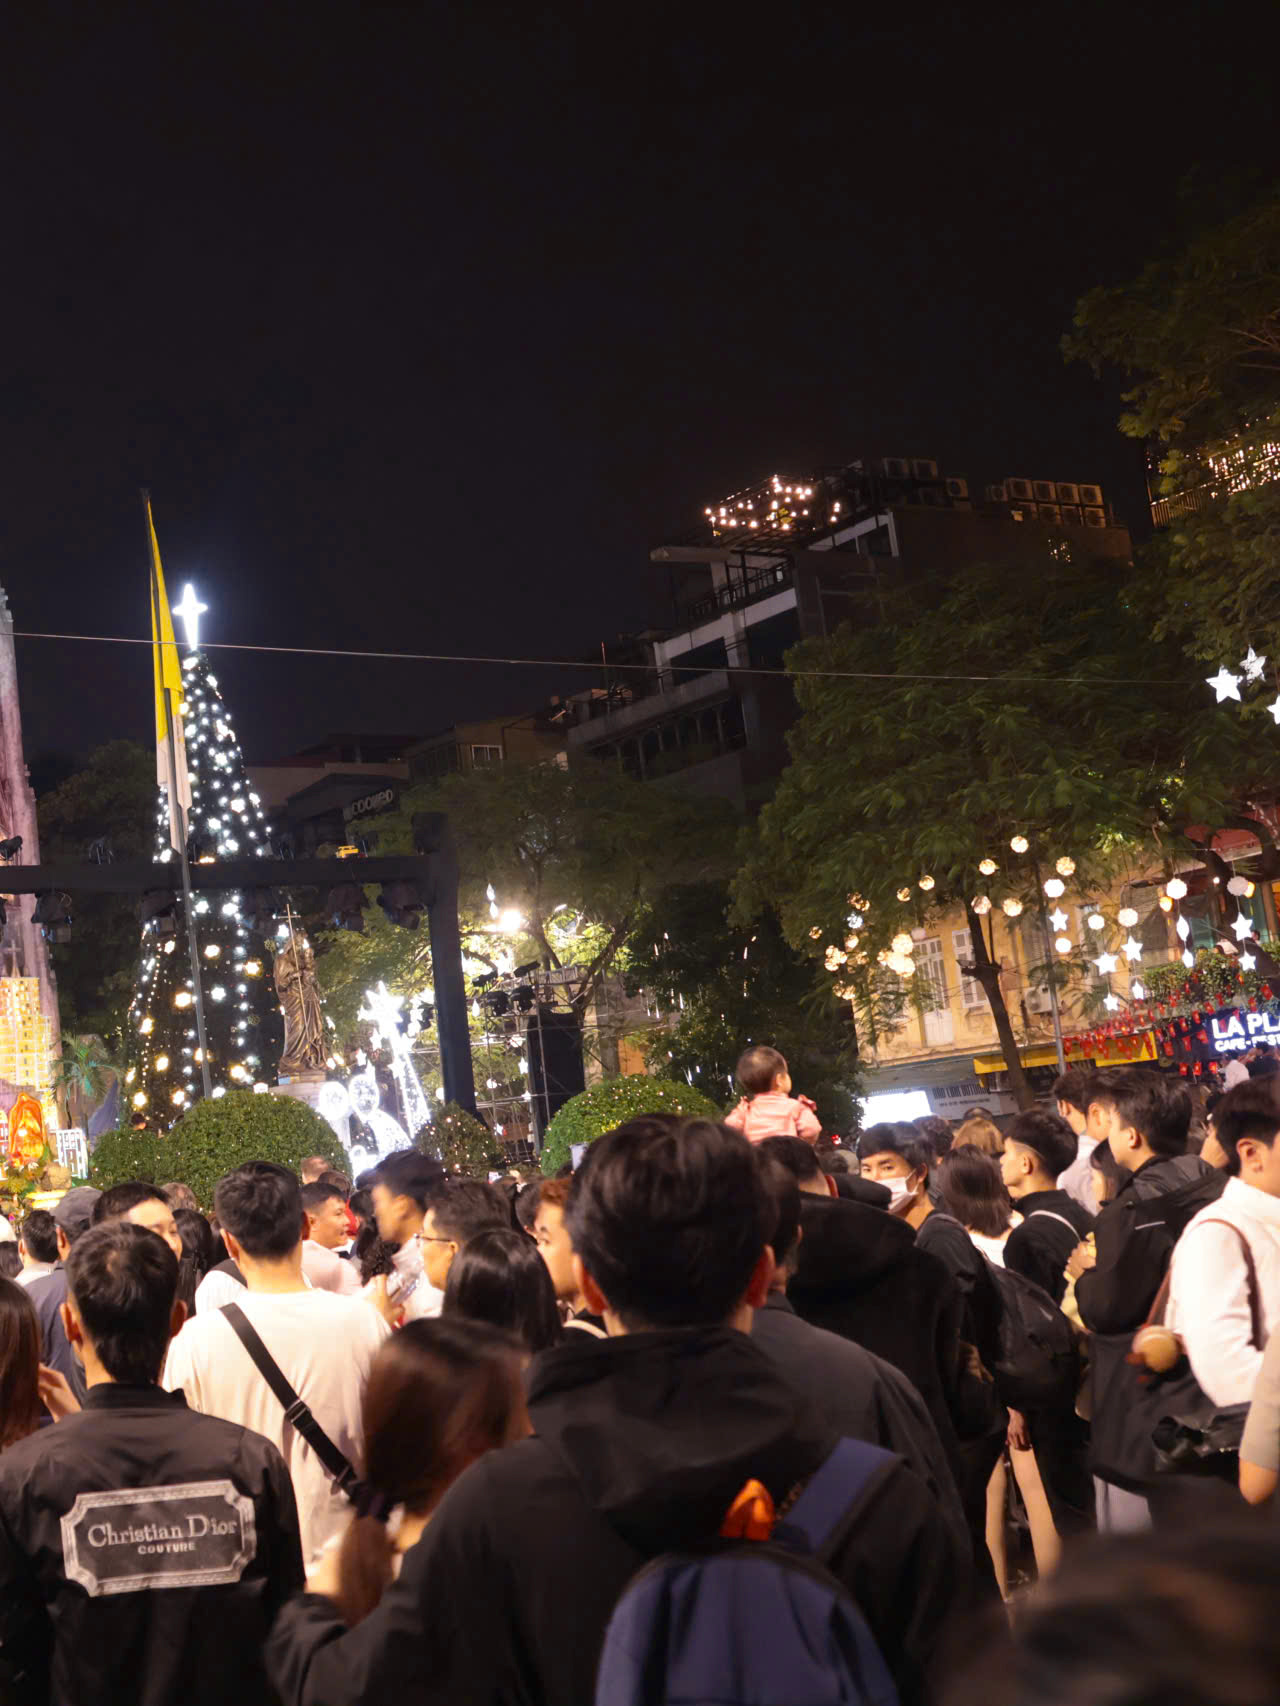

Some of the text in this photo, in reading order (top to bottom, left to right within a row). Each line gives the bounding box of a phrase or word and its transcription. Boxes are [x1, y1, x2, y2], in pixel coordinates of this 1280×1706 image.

[1211, 1012, 1280, 1039] LA PL
[87, 1514, 238, 1548] Christian Dior
[137, 1541, 197, 1556] COUTURE
